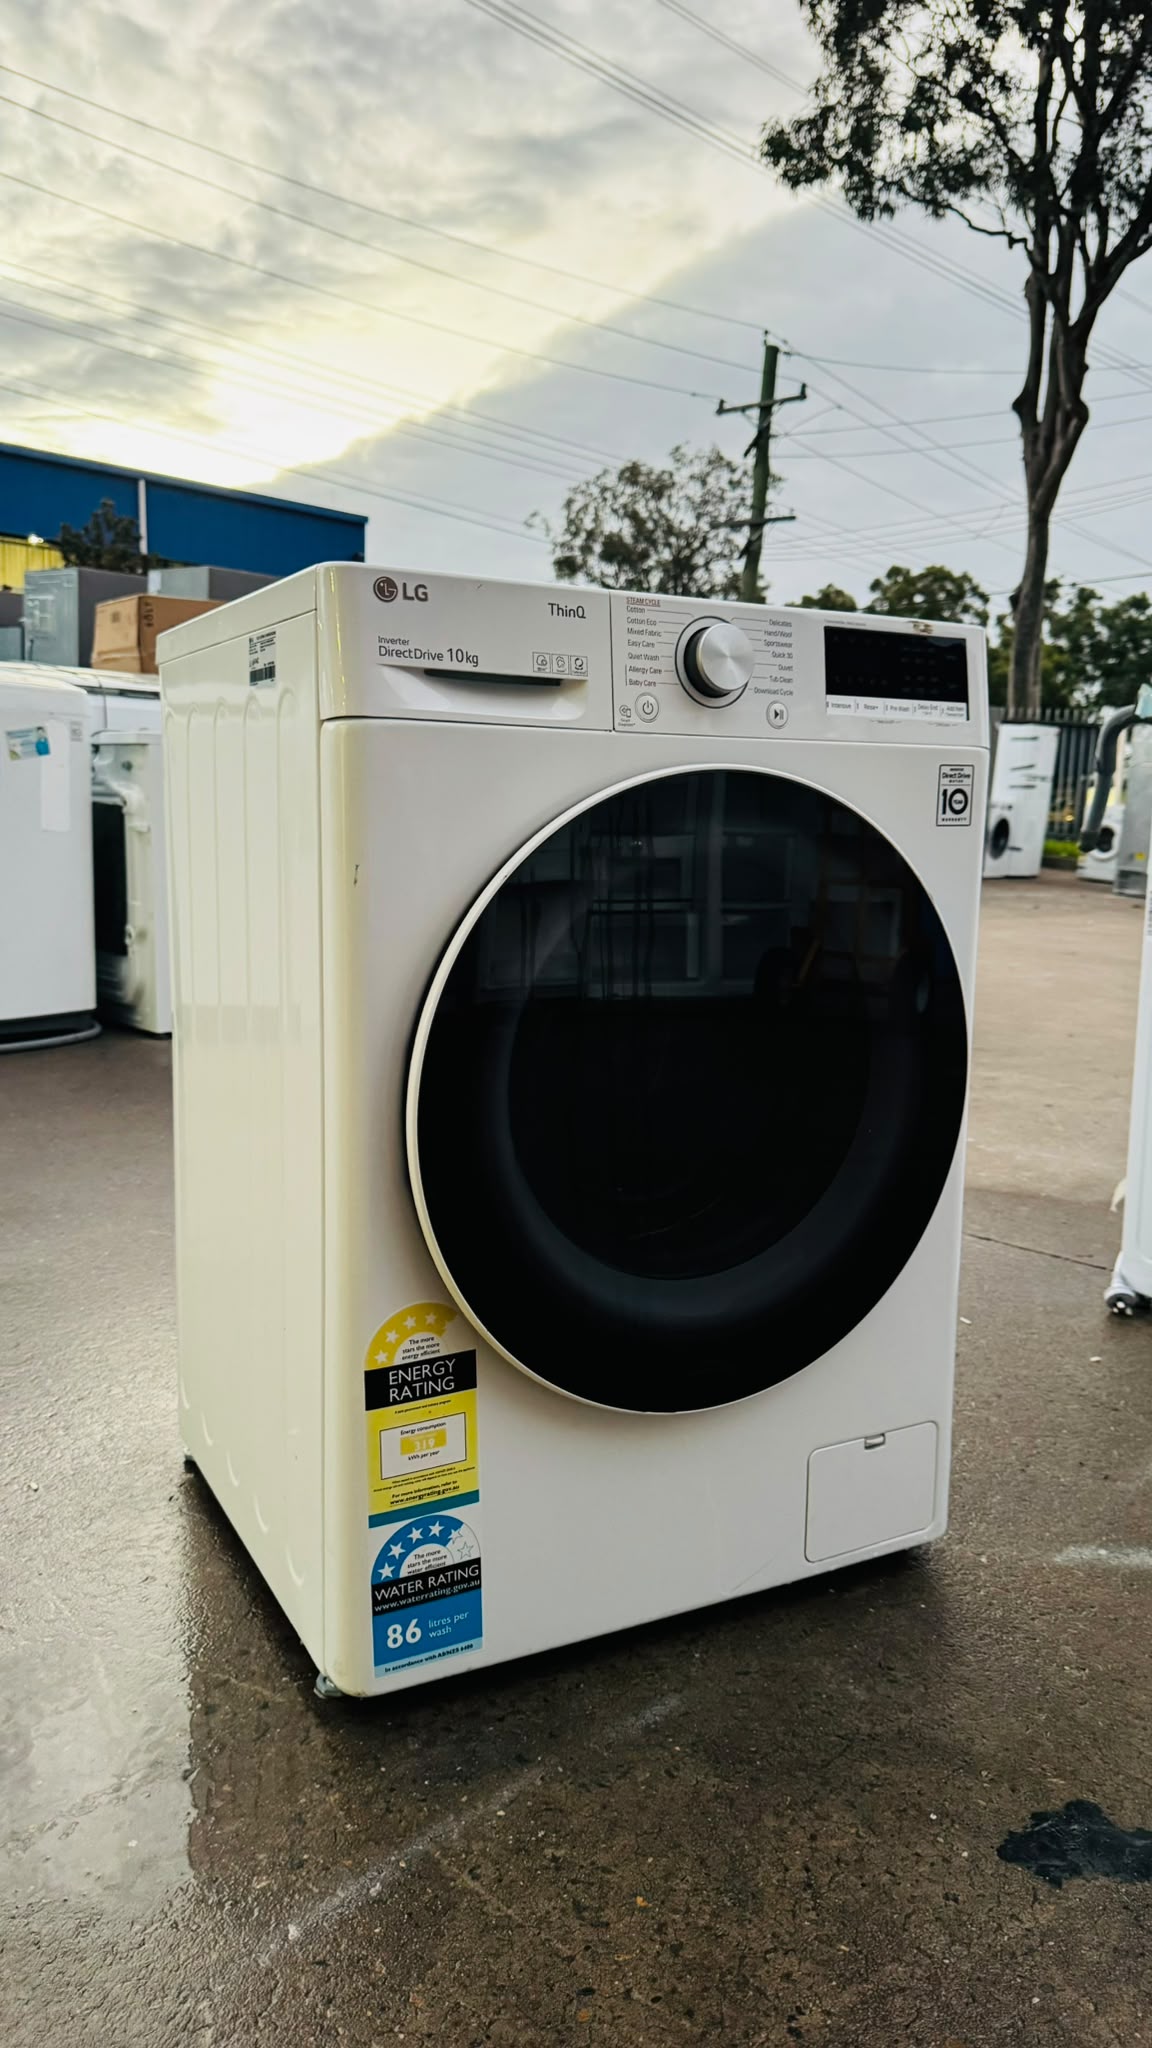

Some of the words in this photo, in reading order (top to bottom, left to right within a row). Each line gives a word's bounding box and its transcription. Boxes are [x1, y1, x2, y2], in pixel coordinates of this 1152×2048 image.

[403, 582, 428, 602] LG
[548, 603, 586, 619] ThinQ
[627, 627, 644, 635] Mixed
[645, 629, 662, 637] Fabric
[378, 636, 410, 646] Inverter
[628, 639, 641, 648] Easy
[628, 652, 643, 660] Quiet
[644, 653, 659, 661] Wash
[628, 665, 648, 674] Allergy
[628, 679, 643, 687] Baby
[754, 687, 779, 695] Download
[780, 688, 793, 696] Cycle
[942, 788, 968, 815] 10
[389, 1358, 456, 1386] ENERGY
[389, 1376, 455, 1402] RATING
[400, 1428, 416, 1436] Energy
[417, 1422, 446, 1432] consumption
[414, 1438, 436, 1452] 319
[430, 1450, 440, 1458] year
[390, 1485, 460, 1505] www.energyrating.gov.au
[432, 1554, 447, 1562] more
[425, 1561, 446, 1571] efficient
[374, 1579, 424, 1601] WATER
[428, 1564, 479, 1588] RATING
[374, 1579, 480, 1612] www.waterrating.gov.au
[428, 1616, 451, 1628] litres
[453, 1611, 469, 1624] per
[387, 1618, 422, 1649] 86
[428, 1626, 452, 1638] wash
[392, 1660, 423, 1671] accordance
[425, 1654, 437, 1662] with
